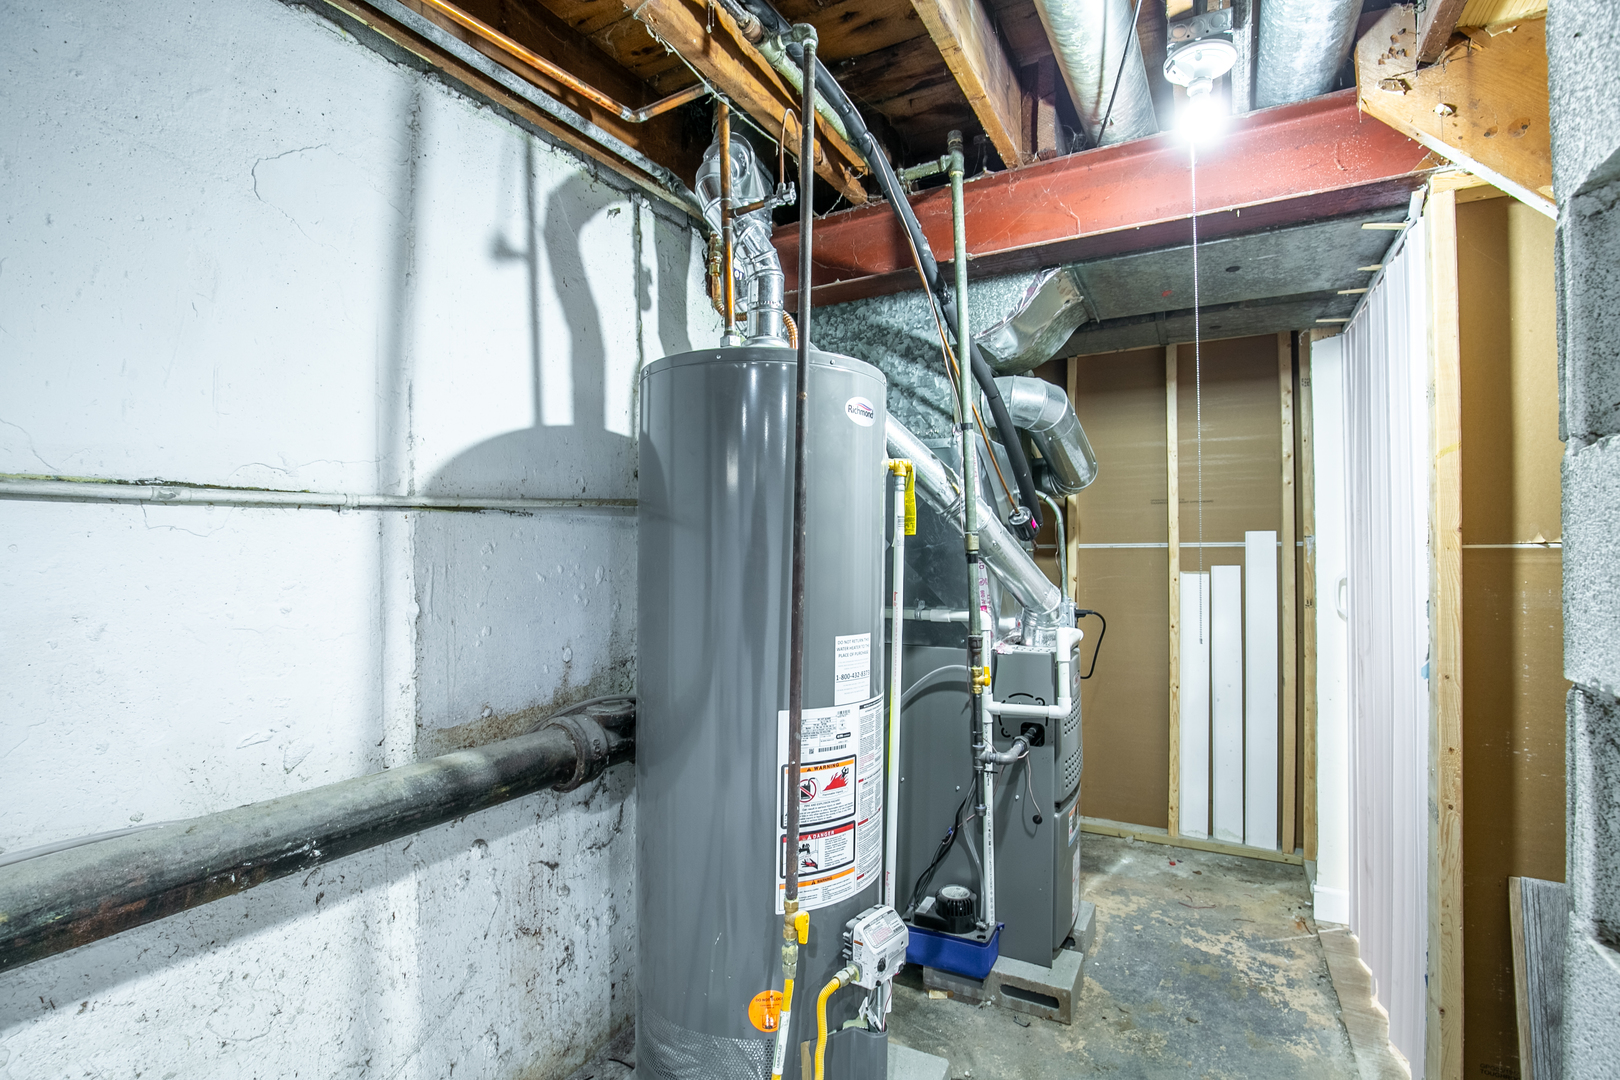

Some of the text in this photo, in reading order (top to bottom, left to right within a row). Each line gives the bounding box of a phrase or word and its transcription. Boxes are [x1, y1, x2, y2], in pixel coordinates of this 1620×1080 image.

[847, 404, 874, 419] Richmond
[814, 762, 840, 770] WARNING
[813, 830, 835, 839] DANGER
